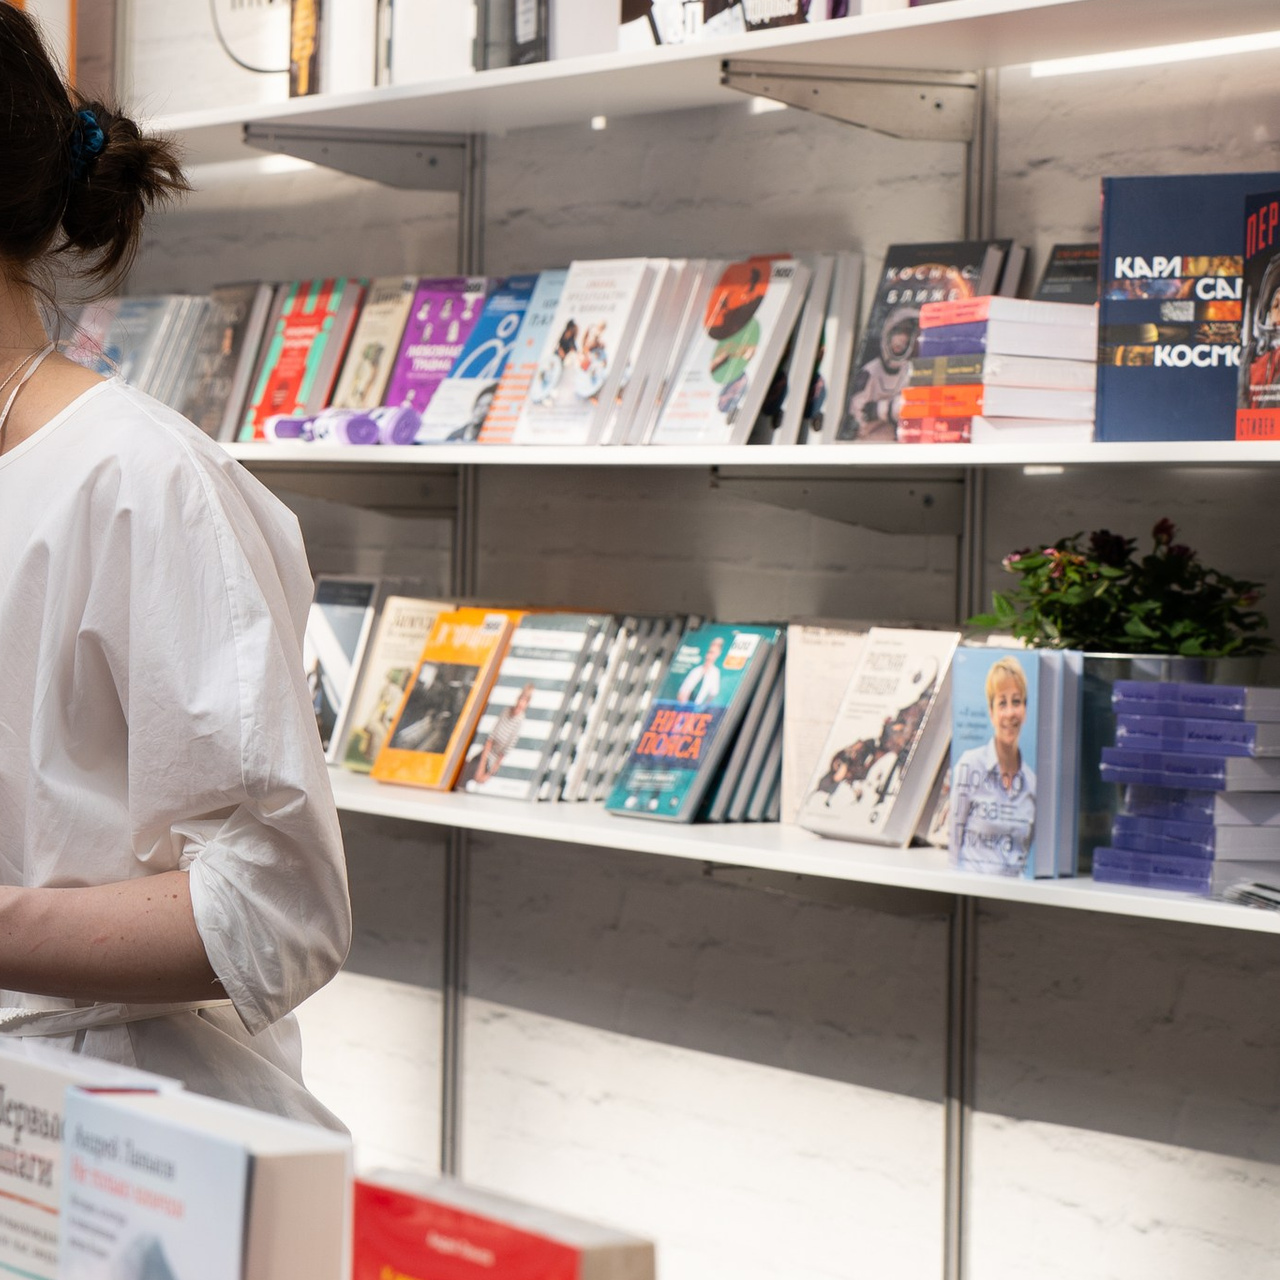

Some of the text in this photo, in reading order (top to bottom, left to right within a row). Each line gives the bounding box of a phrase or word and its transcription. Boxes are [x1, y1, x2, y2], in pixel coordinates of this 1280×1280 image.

[1246, 200, 1280, 259] ПЕР
[1114, 255, 1183, 279] КАРЛ
[887, 288, 961, 305] БЛИЖЕ
[650, 709, 713, 736] НИЖЕ
[637, 731, 703, 760] ПОЯСА
[956, 763, 1022, 798] Доктор
[954, 792, 999, 822] Лиза
